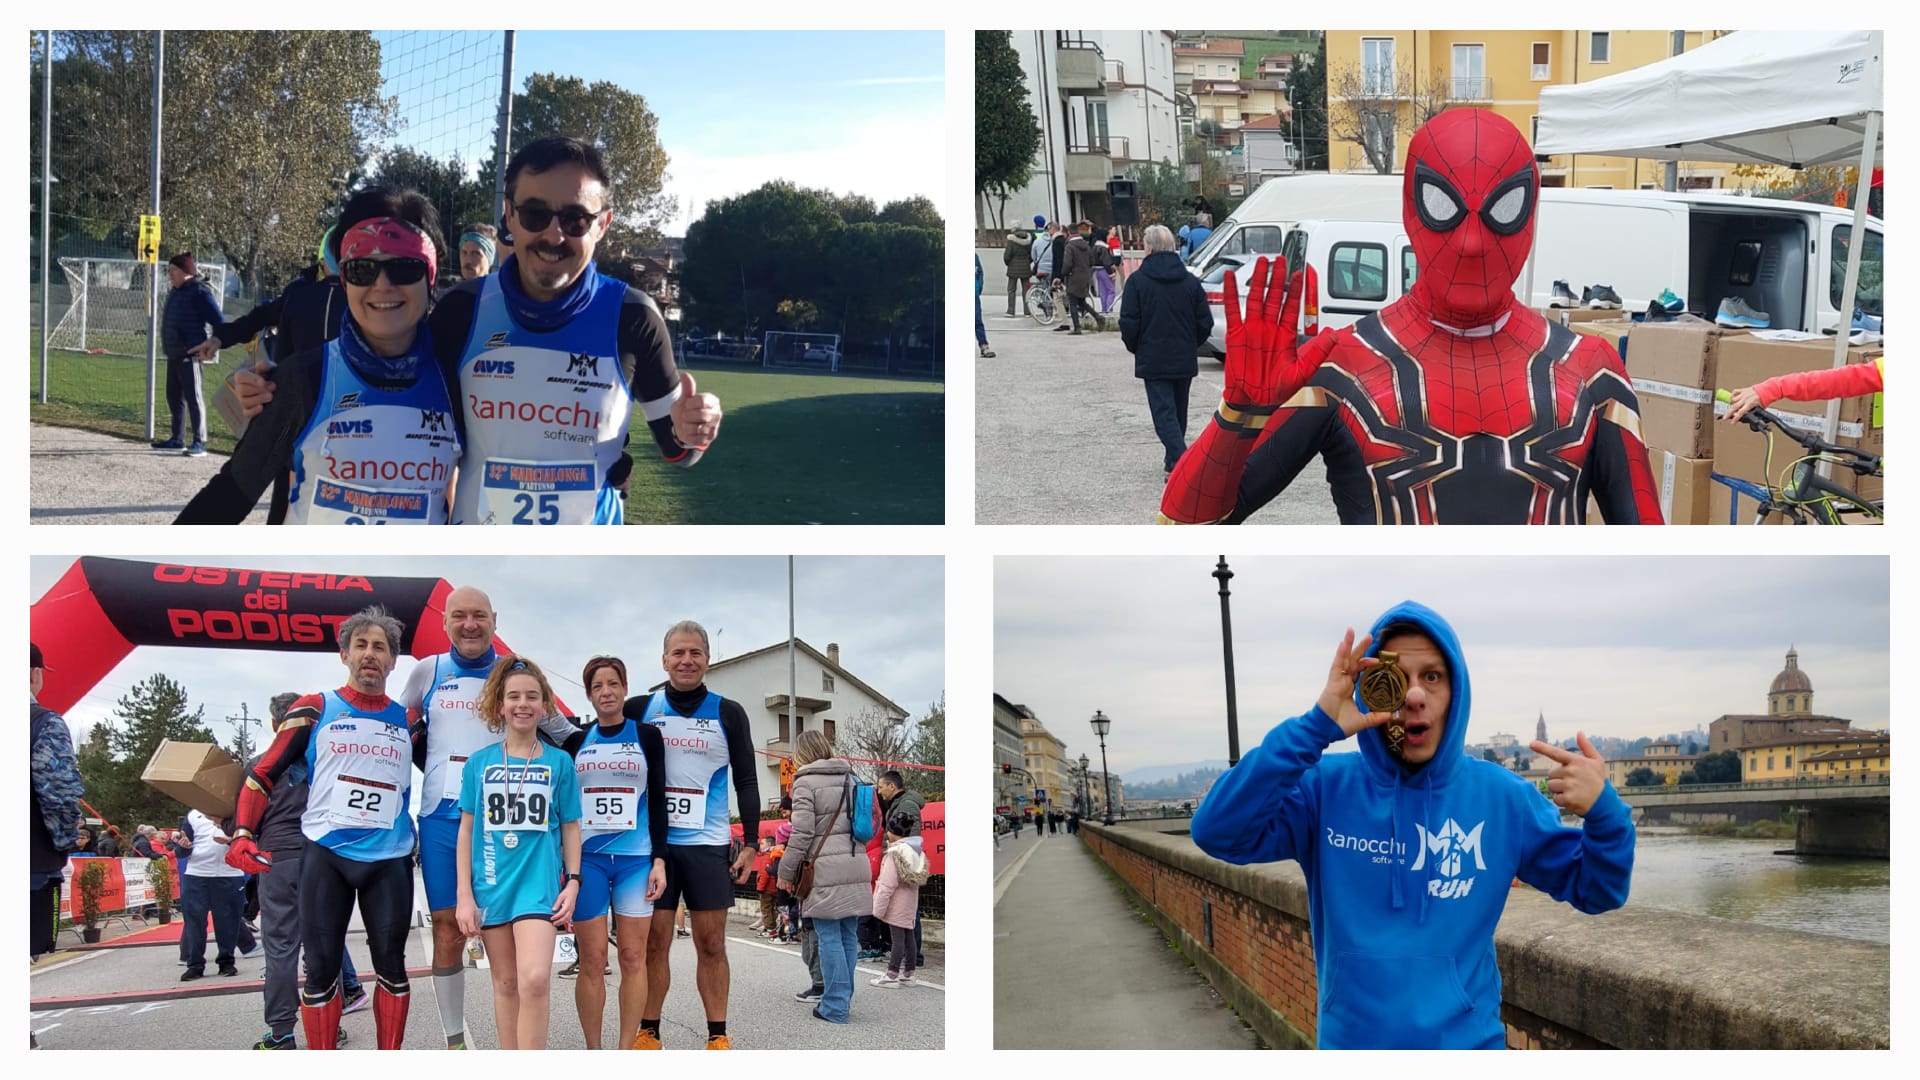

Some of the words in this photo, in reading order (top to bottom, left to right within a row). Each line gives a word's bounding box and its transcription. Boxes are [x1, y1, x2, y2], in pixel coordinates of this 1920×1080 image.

[473, 359, 515, 375] AVIS
[469, 394, 600, 429] Ranocchi
[328, 419, 373, 434] AVIS
[510, 467, 588, 482] MARCIALONGA
[512, 493, 560, 525] 25
[153, 564, 374, 592] OSTERIA
[244, 589, 288, 611] dei
[167, 608, 353, 643] PODIST
[329, 723, 357, 731] AVIS
[329, 741, 402, 762] Ranocchi
[347, 789, 382, 812] 22
[488, 793, 546, 826] 859
[595, 797, 623, 815] 55
[666, 797, 691, 815] 59
[1327, 827, 1406, 855] Ranocchi
[1372, 855, 1405, 865] softwre
[1427, 875, 1476, 900] RUN
